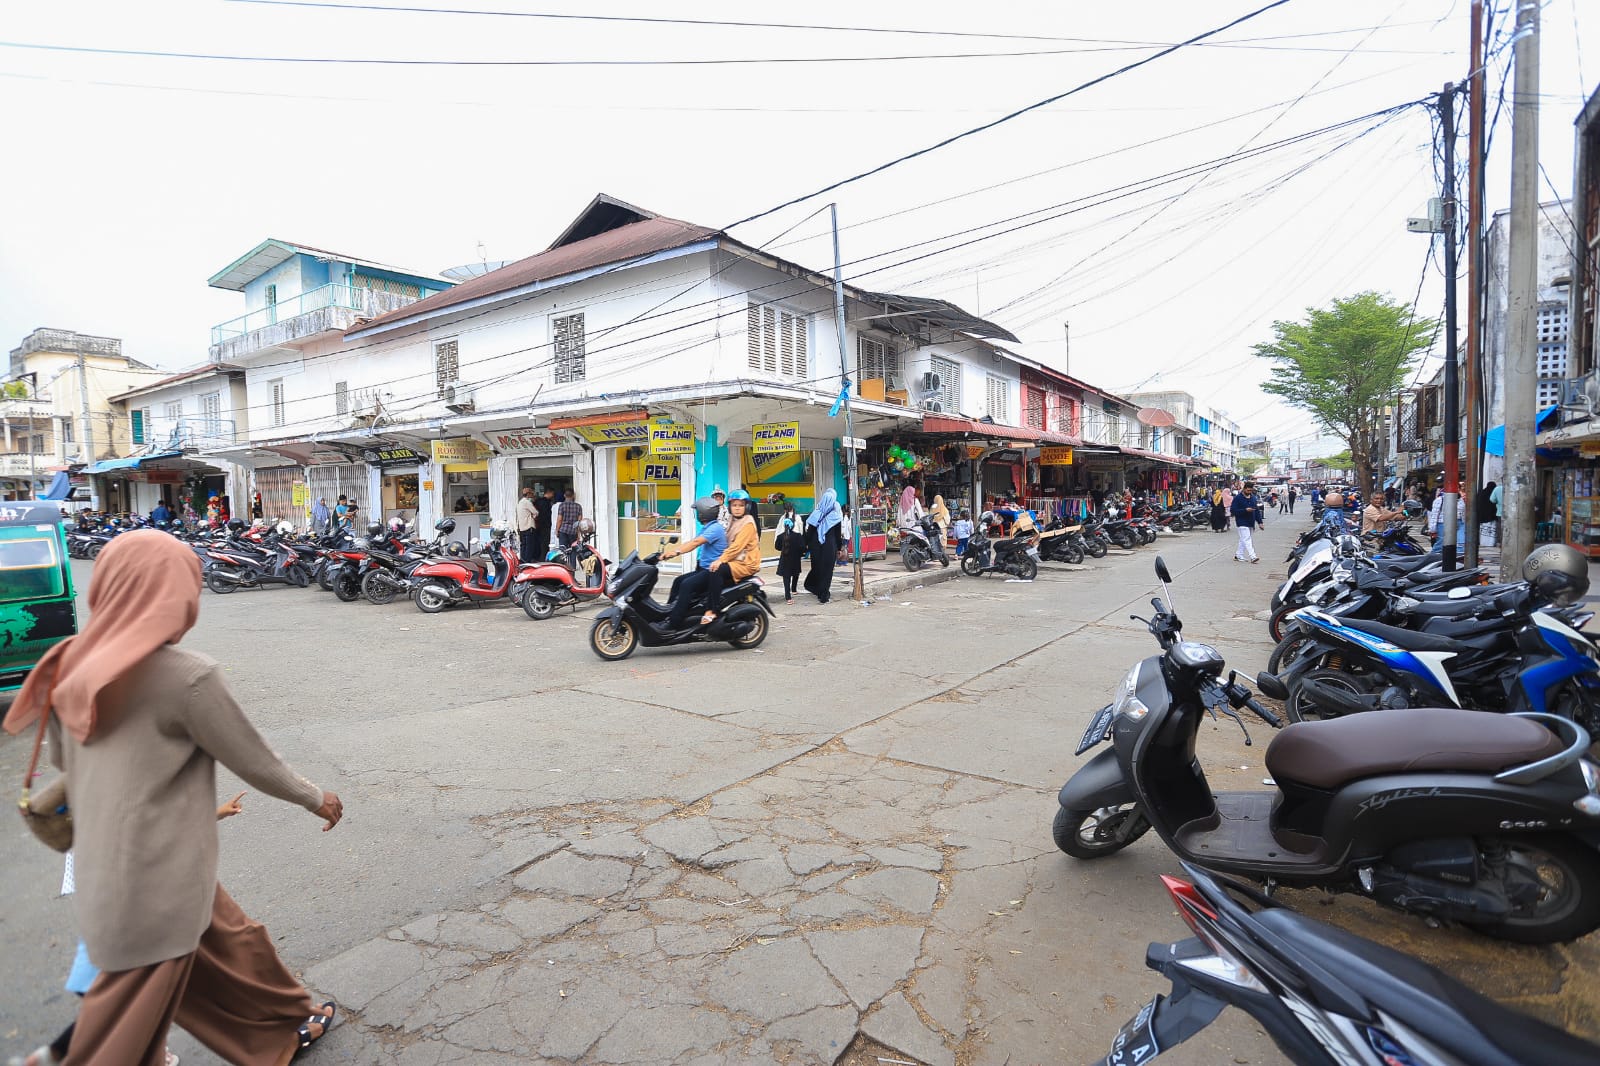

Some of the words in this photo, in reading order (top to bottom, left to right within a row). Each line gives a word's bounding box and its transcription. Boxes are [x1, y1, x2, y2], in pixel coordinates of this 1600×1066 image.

[601, 425, 649, 439] PELAN
[652, 430, 692, 440] PELANGI
[754, 428, 796, 440] PELANGI
[392, 449, 414, 459] JAYA
